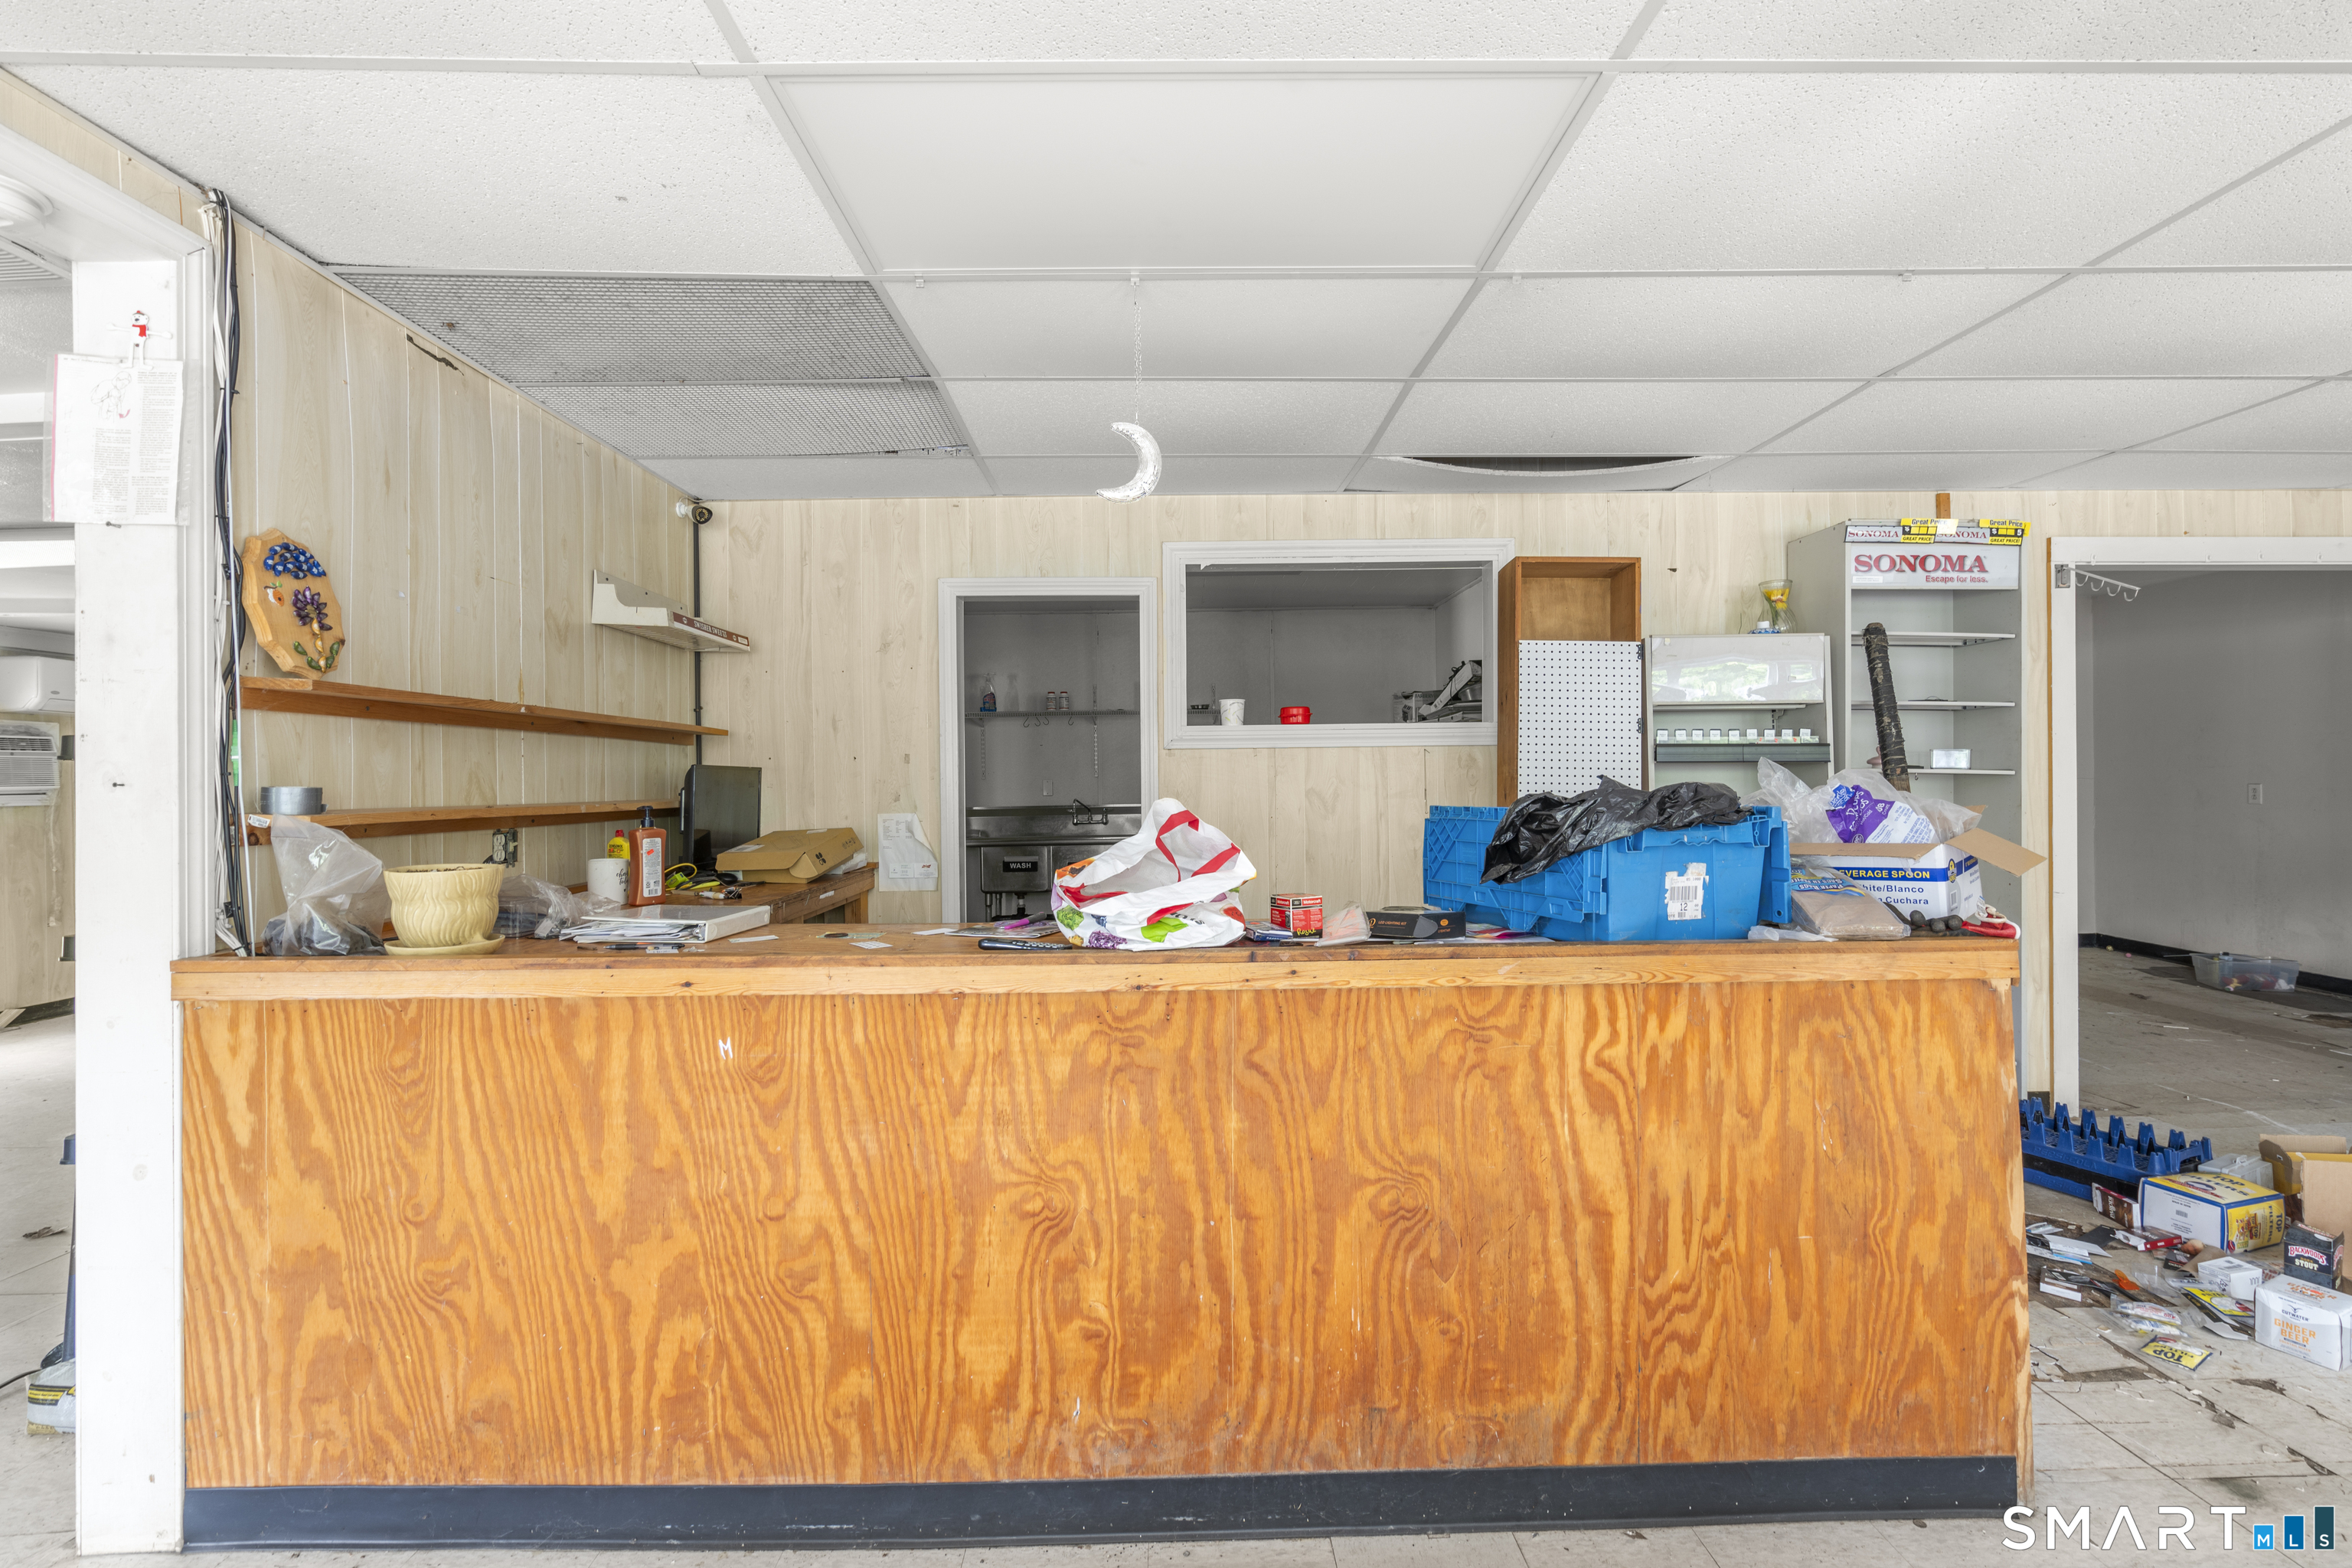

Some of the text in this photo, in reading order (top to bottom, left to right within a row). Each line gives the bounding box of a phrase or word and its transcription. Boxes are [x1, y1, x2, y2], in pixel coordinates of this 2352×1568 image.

[1854, 554, 1988, 573] SONOMA
[1926, 575, 1955, 584] Escape
[694, 620, 727, 638] SWISHER SWEETS
[1840, 870, 1930, 879] EVERAGE SPOON
[1860, 884, 1924, 893] hite/Blanco
[1680, 902, 1688, 911] 12
[1886, 896, 1929, 905] Cuchara
[2212, 1175, 2246, 1187] TOP
[2288, 1246, 2326, 1265] BACKWOODS
[2295, 1259, 2318, 1271] STOUT
[2282, 1309, 2309, 1321] CUTWATER
[2274, 1318, 2316, 1339] GINGER
[2281, 1328, 2310, 1345] BEER
[2153, 1349, 2182, 1362] TOP
